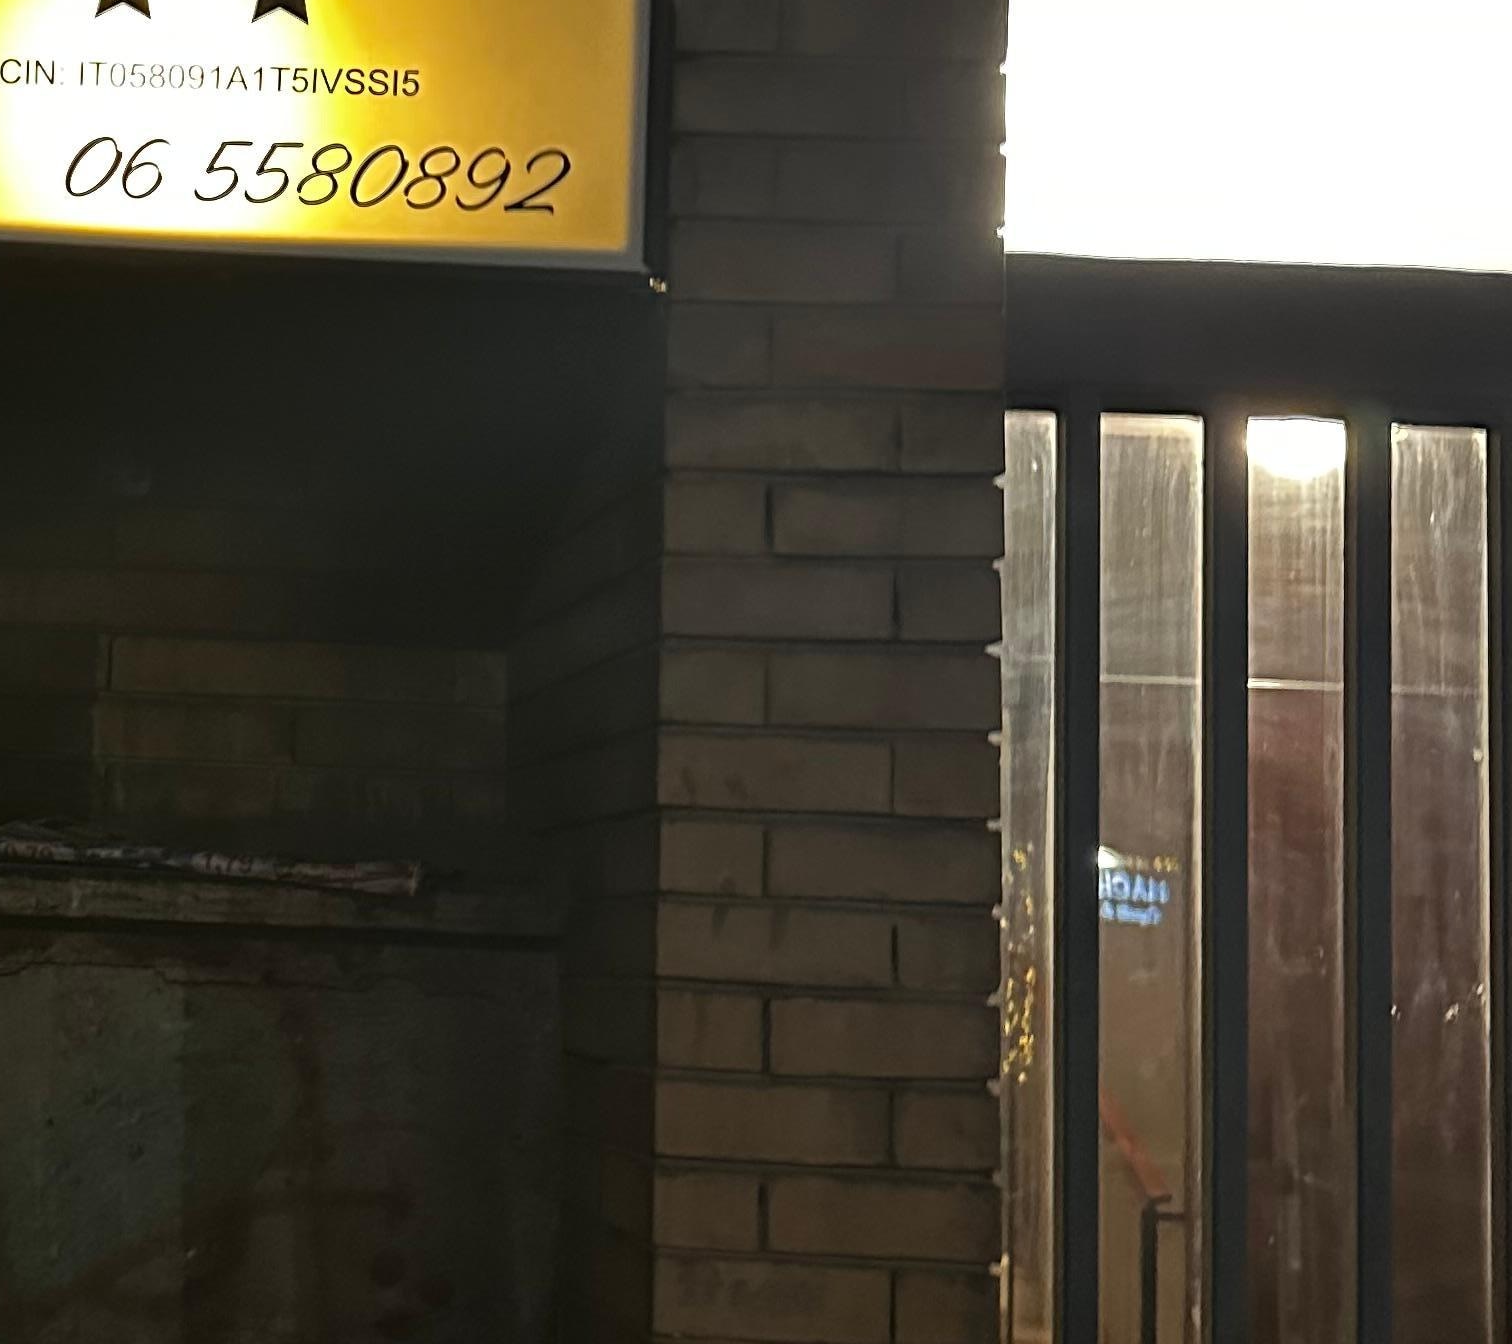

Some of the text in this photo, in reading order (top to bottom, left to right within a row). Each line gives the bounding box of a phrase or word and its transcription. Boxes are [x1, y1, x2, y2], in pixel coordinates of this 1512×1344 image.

[0, 58, 65, 86] CIN:
[65, 136, 171, 199] 06
[193, 139, 572, 215] 5580892
